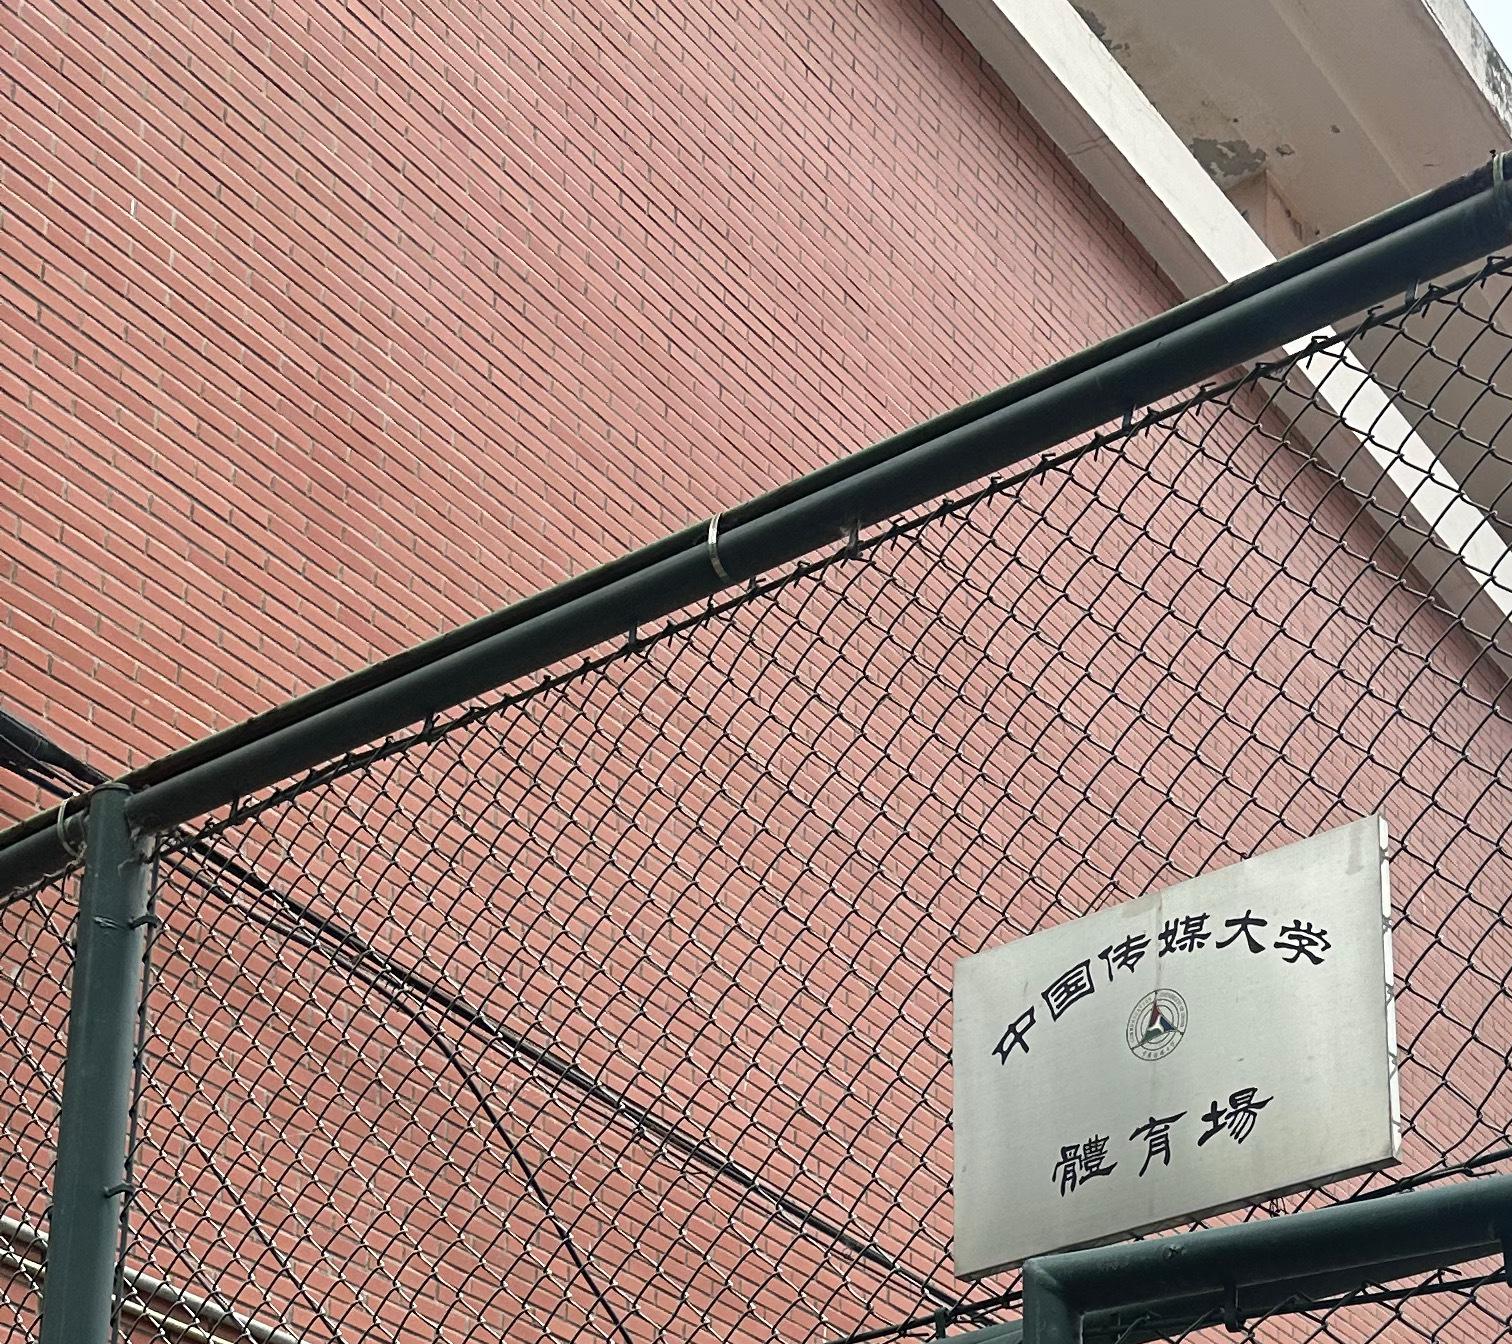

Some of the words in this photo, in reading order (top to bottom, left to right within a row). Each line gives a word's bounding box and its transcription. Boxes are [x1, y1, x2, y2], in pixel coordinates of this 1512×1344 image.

[991, 909, 1332, 1066] 中国传媒大学
[1051, 1087, 1274, 1198] 體育場
